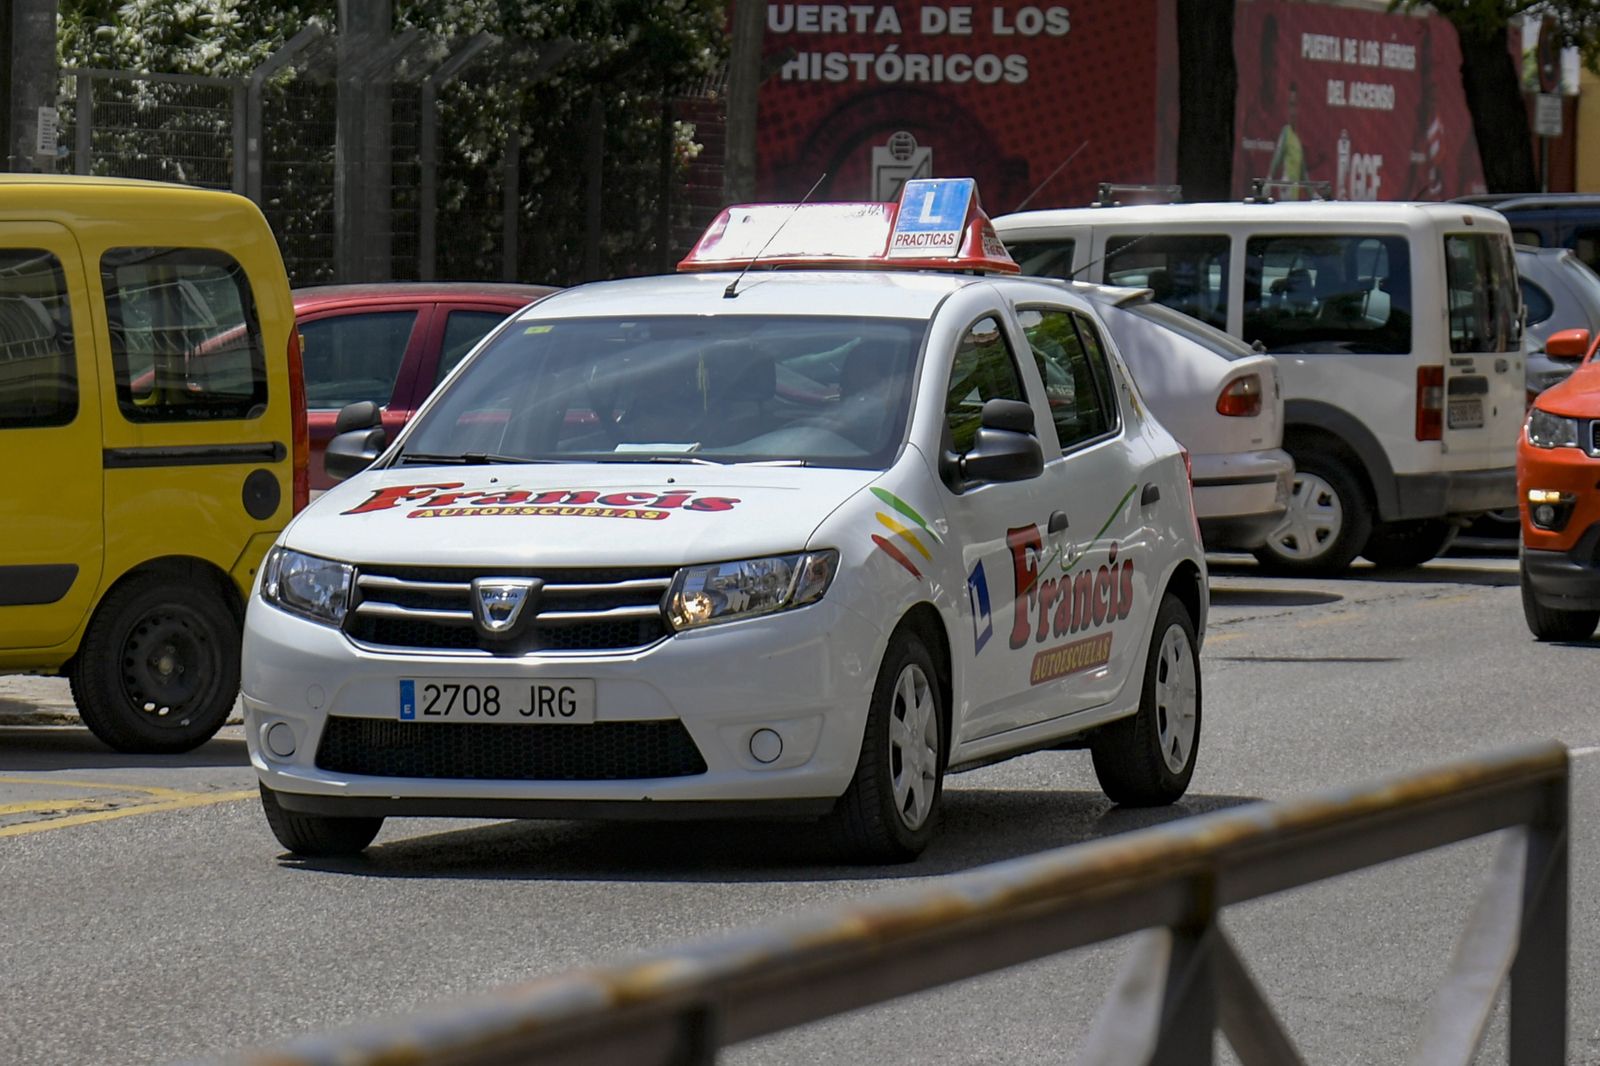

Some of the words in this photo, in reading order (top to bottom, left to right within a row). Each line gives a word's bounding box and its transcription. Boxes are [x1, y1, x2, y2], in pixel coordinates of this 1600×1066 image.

[767, 4, 902, 34] UERTA
[920, 6, 973, 35] DE
[993, 6, 1070, 36] LOS
[781, 45, 1029, 83] HISTÓRICOS
[918, 191, 943, 224] L
[895, 232, 955, 246] PRACTICAS
[340, 482, 742, 515] Francis
[415, 506, 663, 520] AUTOESCUELAS
[1006, 522, 1134, 650] Francis
[1032, 635, 1112, 682] AUTOESCUELAS
[403, 704, 412, 714] E
[423, 684, 501, 716] 2708
[519, 685, 577, 718] JRG
